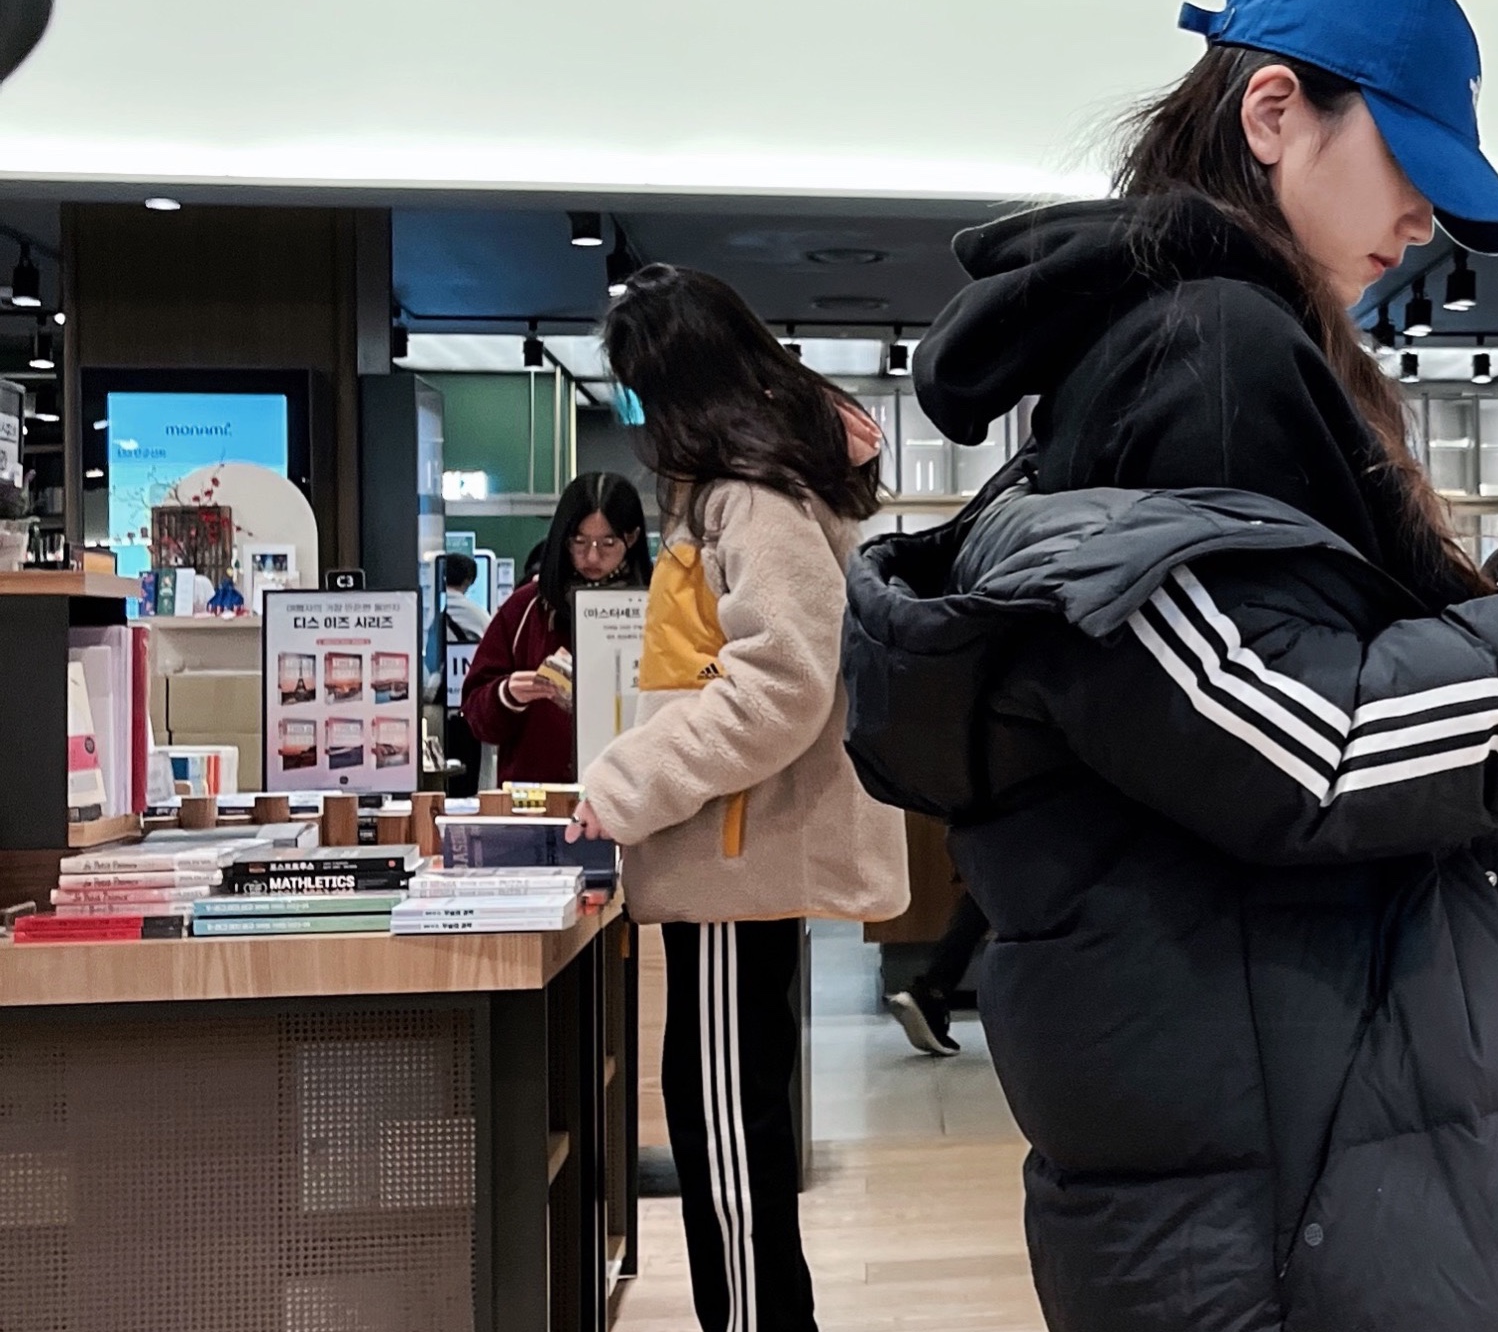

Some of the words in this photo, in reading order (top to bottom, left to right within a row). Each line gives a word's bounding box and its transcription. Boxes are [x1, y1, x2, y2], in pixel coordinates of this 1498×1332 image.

[336, 575, 354, 588] C3
[293, 617, 319, 629] 디스
[324, 617, 350, 629] 이즈
[354, 617, 394, 629] 시리즈
[268, 875, 355, 890] MATHLETICS
